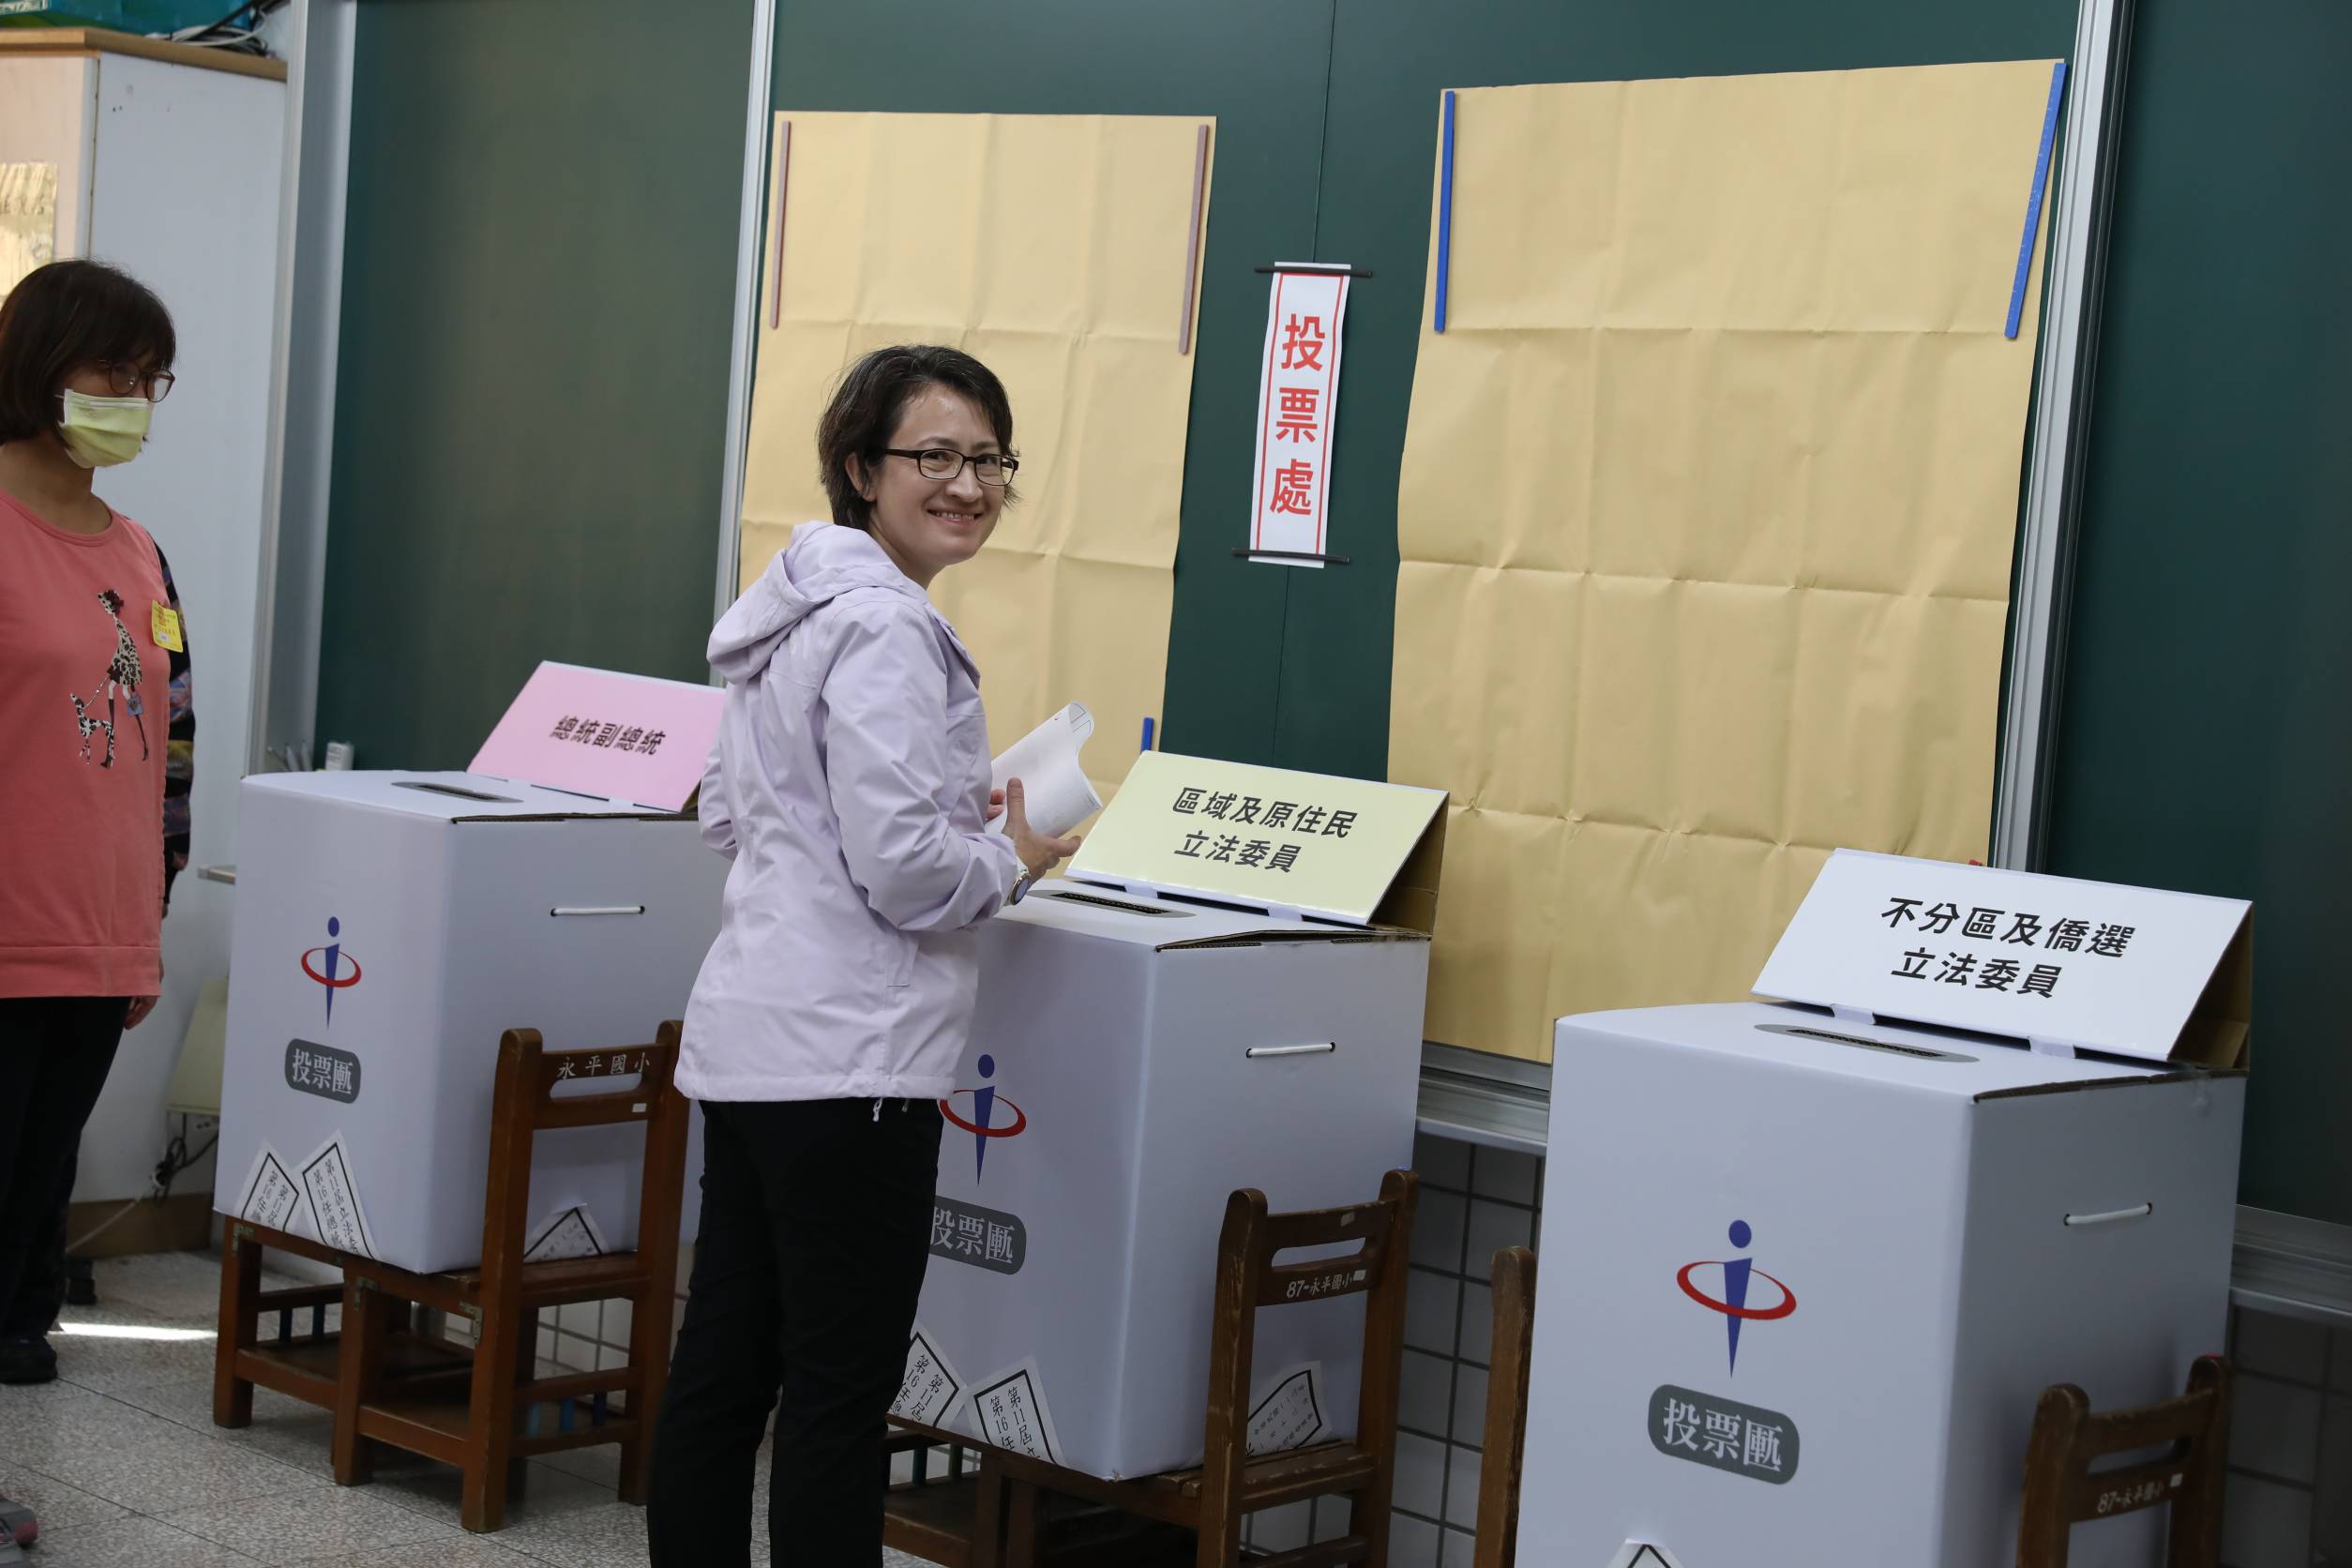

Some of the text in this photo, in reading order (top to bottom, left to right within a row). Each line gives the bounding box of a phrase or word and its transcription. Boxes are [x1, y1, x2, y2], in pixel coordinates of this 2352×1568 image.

[1269, 313, 1326, 516] 投票處
[550, 716, 666, 755] 總統副總統
[1172, 787, 1358, 838] 區域及原住民
[1174, 830, 1302, 873] 立法委員
[1881, 897, 2136, 957] 不分區及僑選
[1891, 947, 2063, 999] 立法委員
[556, 1051, 651, 1080] 永平國小
